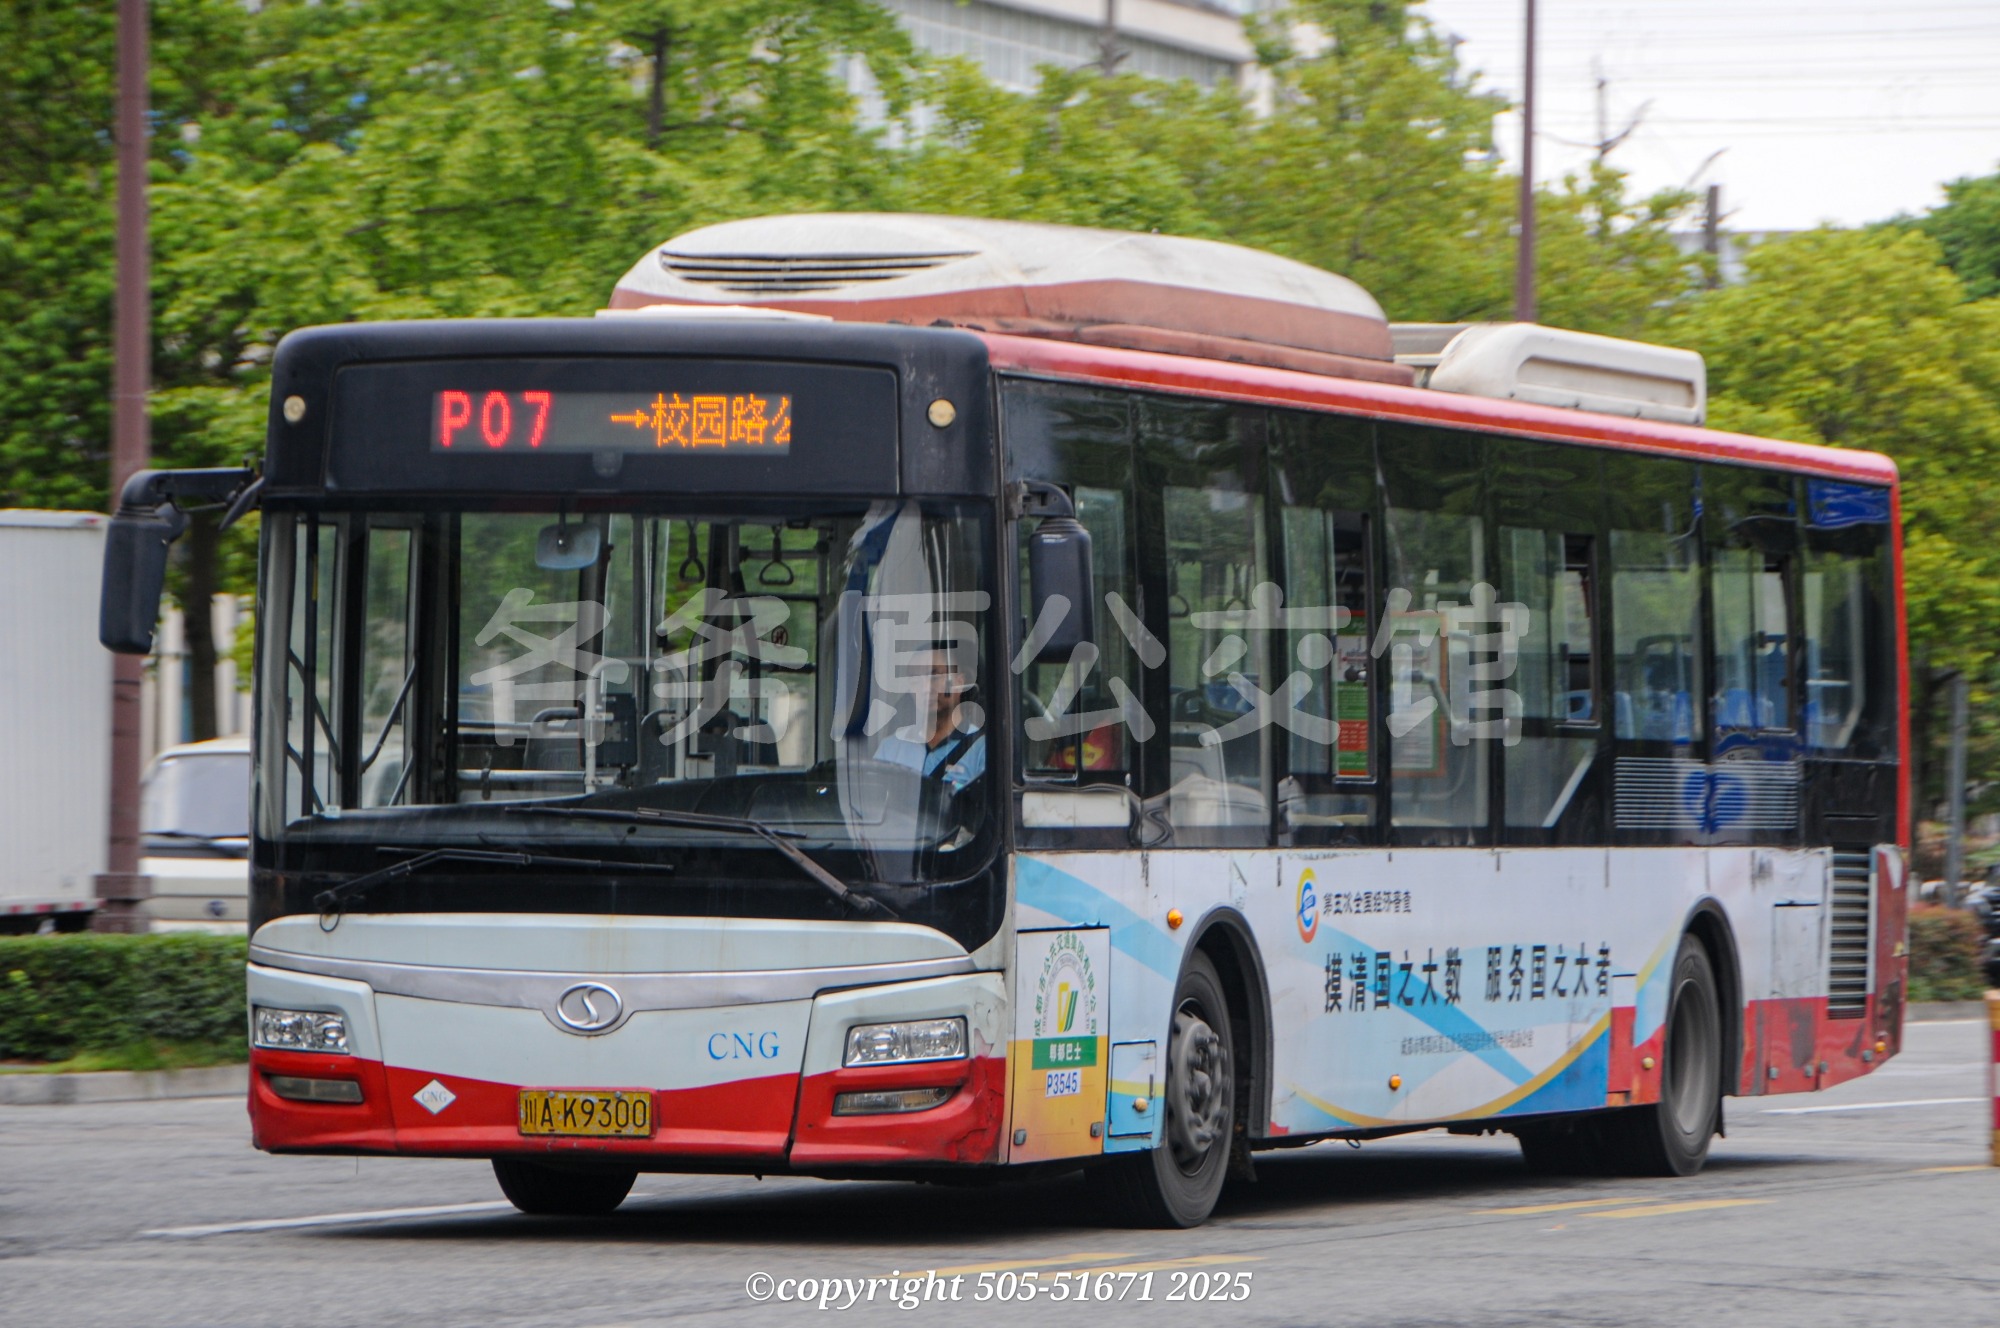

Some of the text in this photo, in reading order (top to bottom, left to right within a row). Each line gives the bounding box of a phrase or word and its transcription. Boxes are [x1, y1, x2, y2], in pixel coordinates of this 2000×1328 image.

[442, 390, 552, 448] P07
[1324, 941, 1611, 1013] 摸清国之大数 服务国之大者
[708, 1031, 779, 1061] CNG
[421, 1090, 447, 1103] CNG
[1047, 1071, 1078, 1096] P3545
